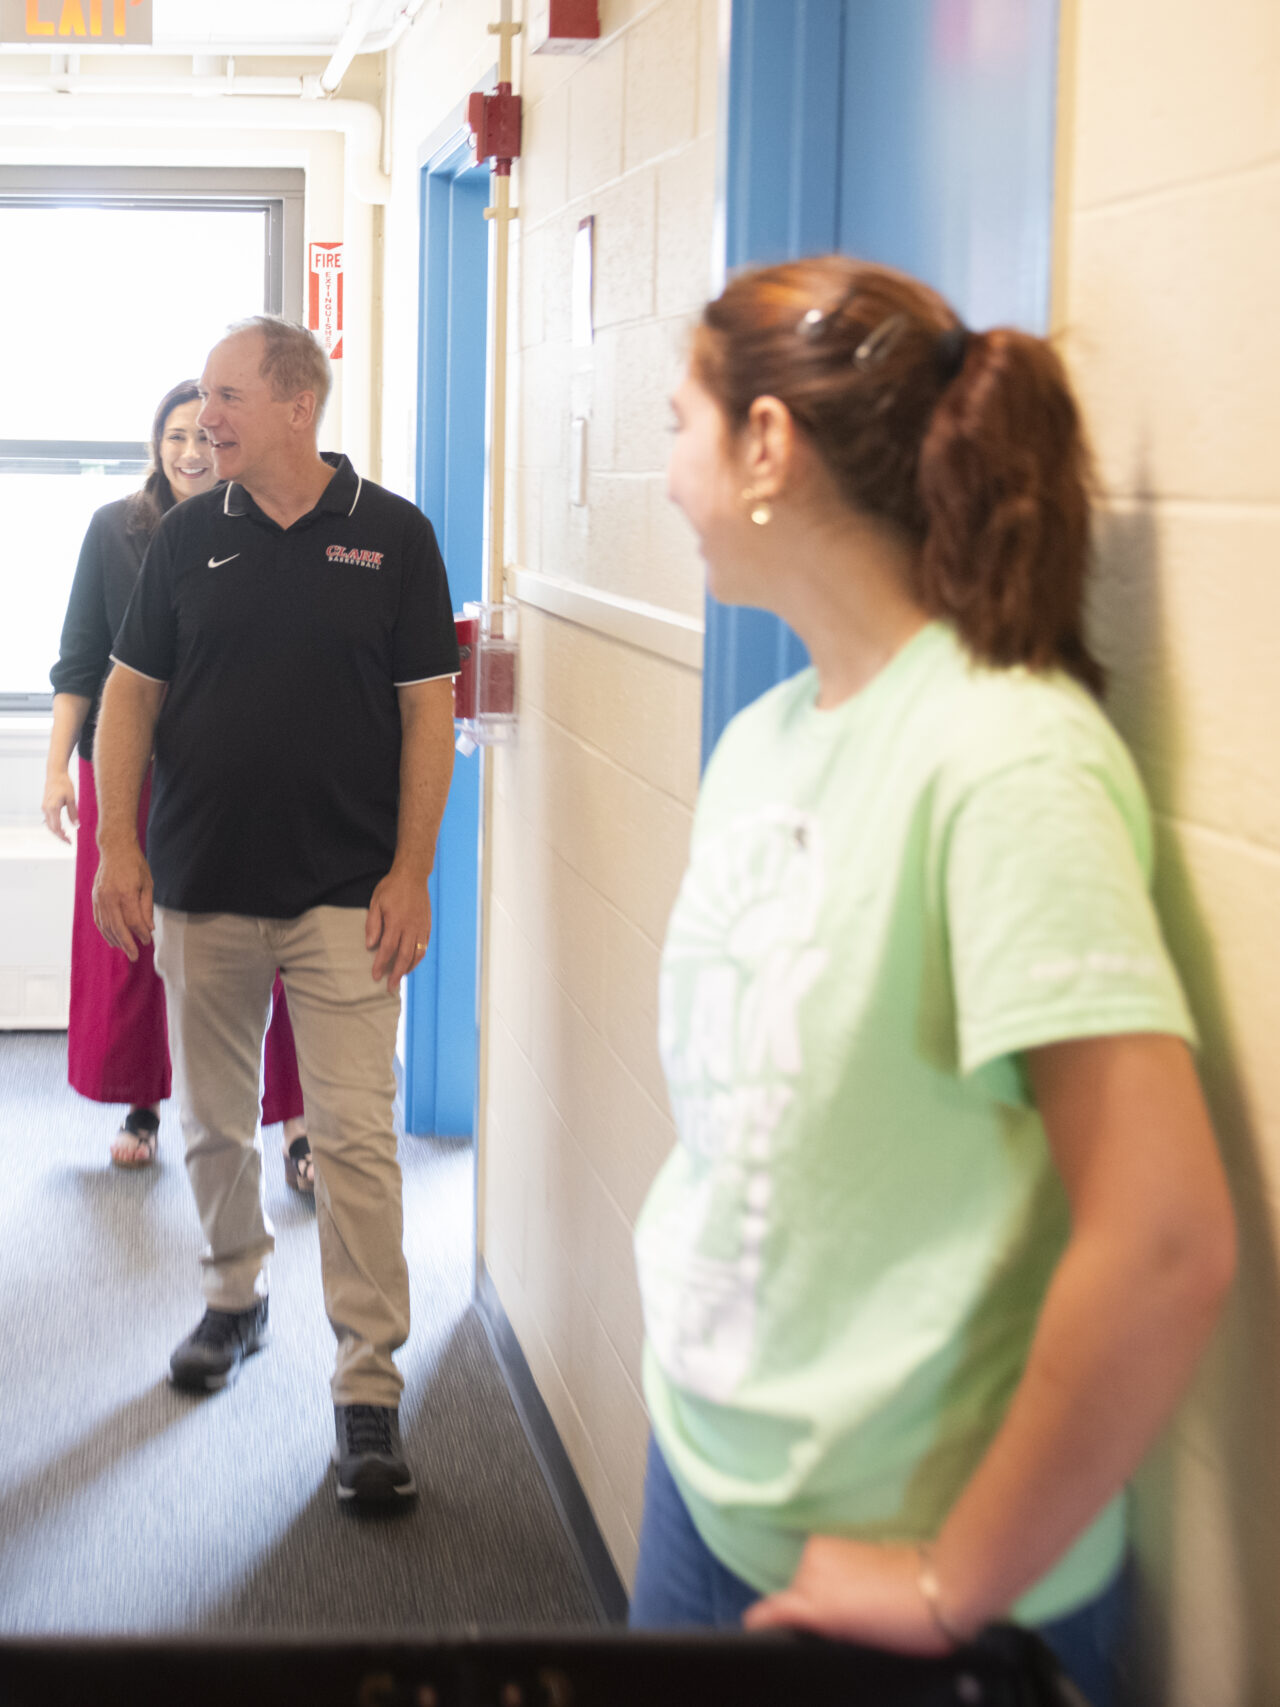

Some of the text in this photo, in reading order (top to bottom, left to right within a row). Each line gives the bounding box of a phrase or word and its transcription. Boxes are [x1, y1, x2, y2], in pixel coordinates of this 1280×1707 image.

[315, 253, 342, 268] FIRE
[324, 271, 332, 349] EXTINGUISHER
[325, 544, 385, 566] CLARK
